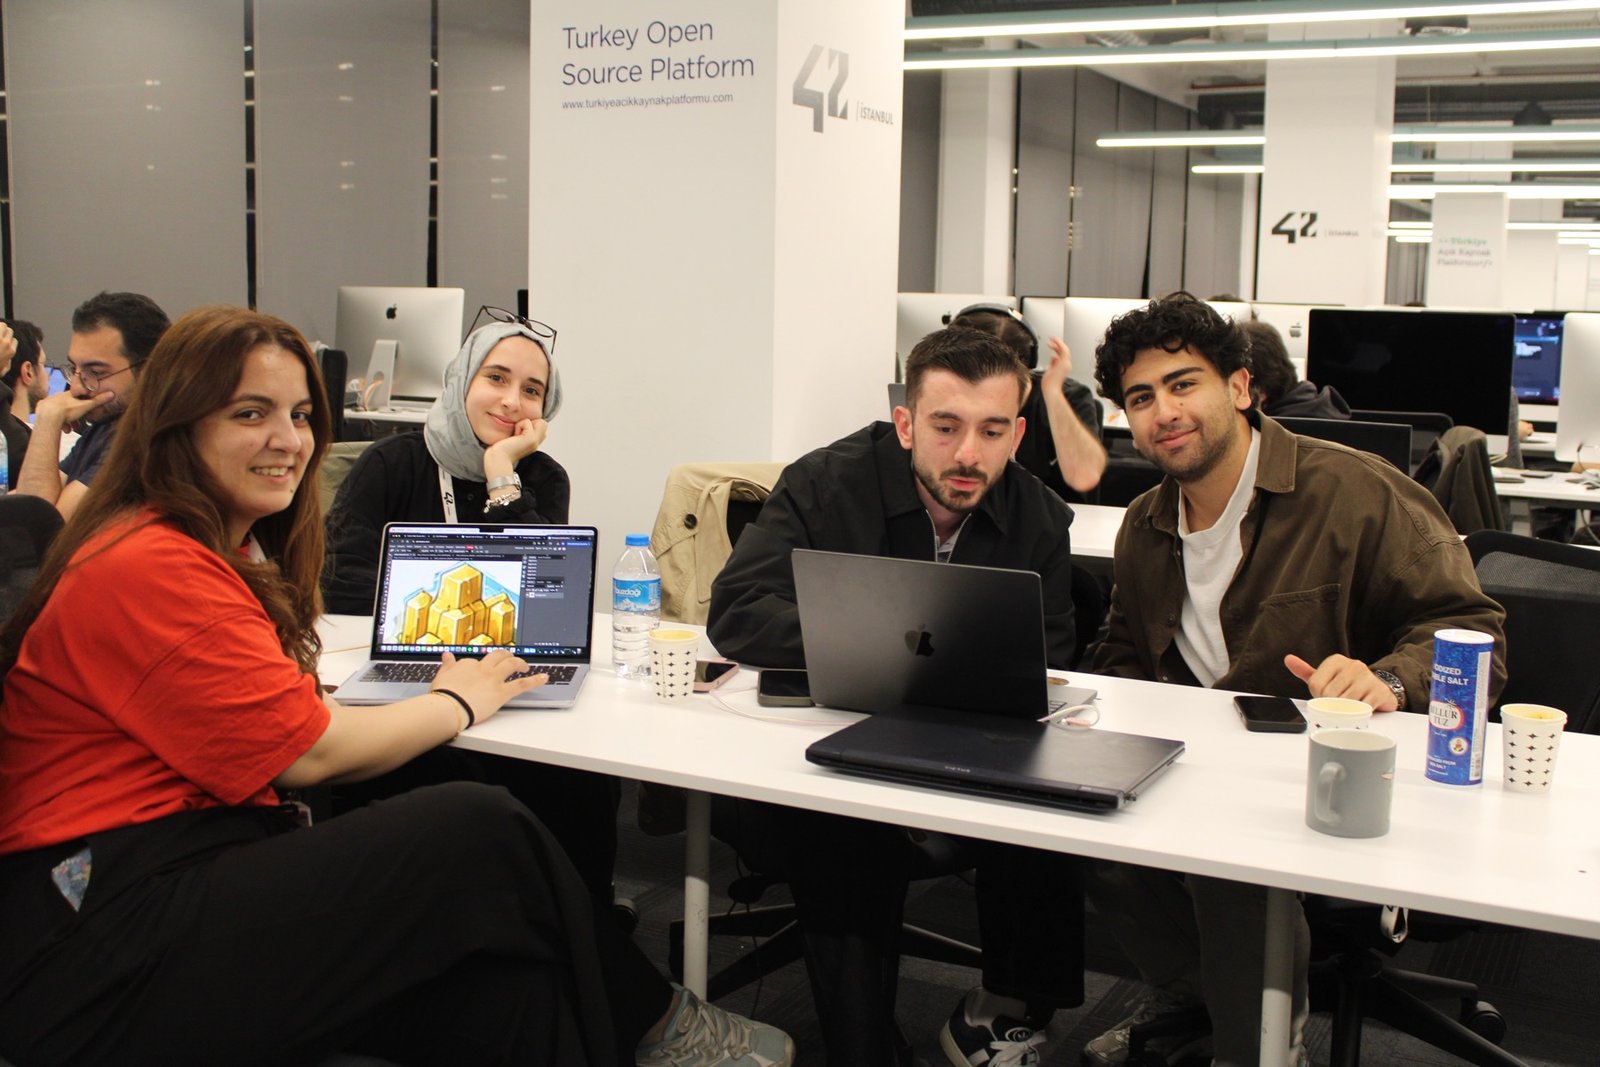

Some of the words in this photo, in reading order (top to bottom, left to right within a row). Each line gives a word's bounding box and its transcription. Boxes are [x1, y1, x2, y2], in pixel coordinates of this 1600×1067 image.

[562, 25, 638, 50] Turkey
[647, 21, 713, 47] Open
[562, 63, 642, 86] Source
[651, 55, 754, 81] Platform
[562, 93, 734, 110] www.turkiyeacikkaynakplatformu.com
[792, 43, 849, 134] 42
[1271, 211, 1318, 244] 42
[1447, 676, 1469, 686] SALT
